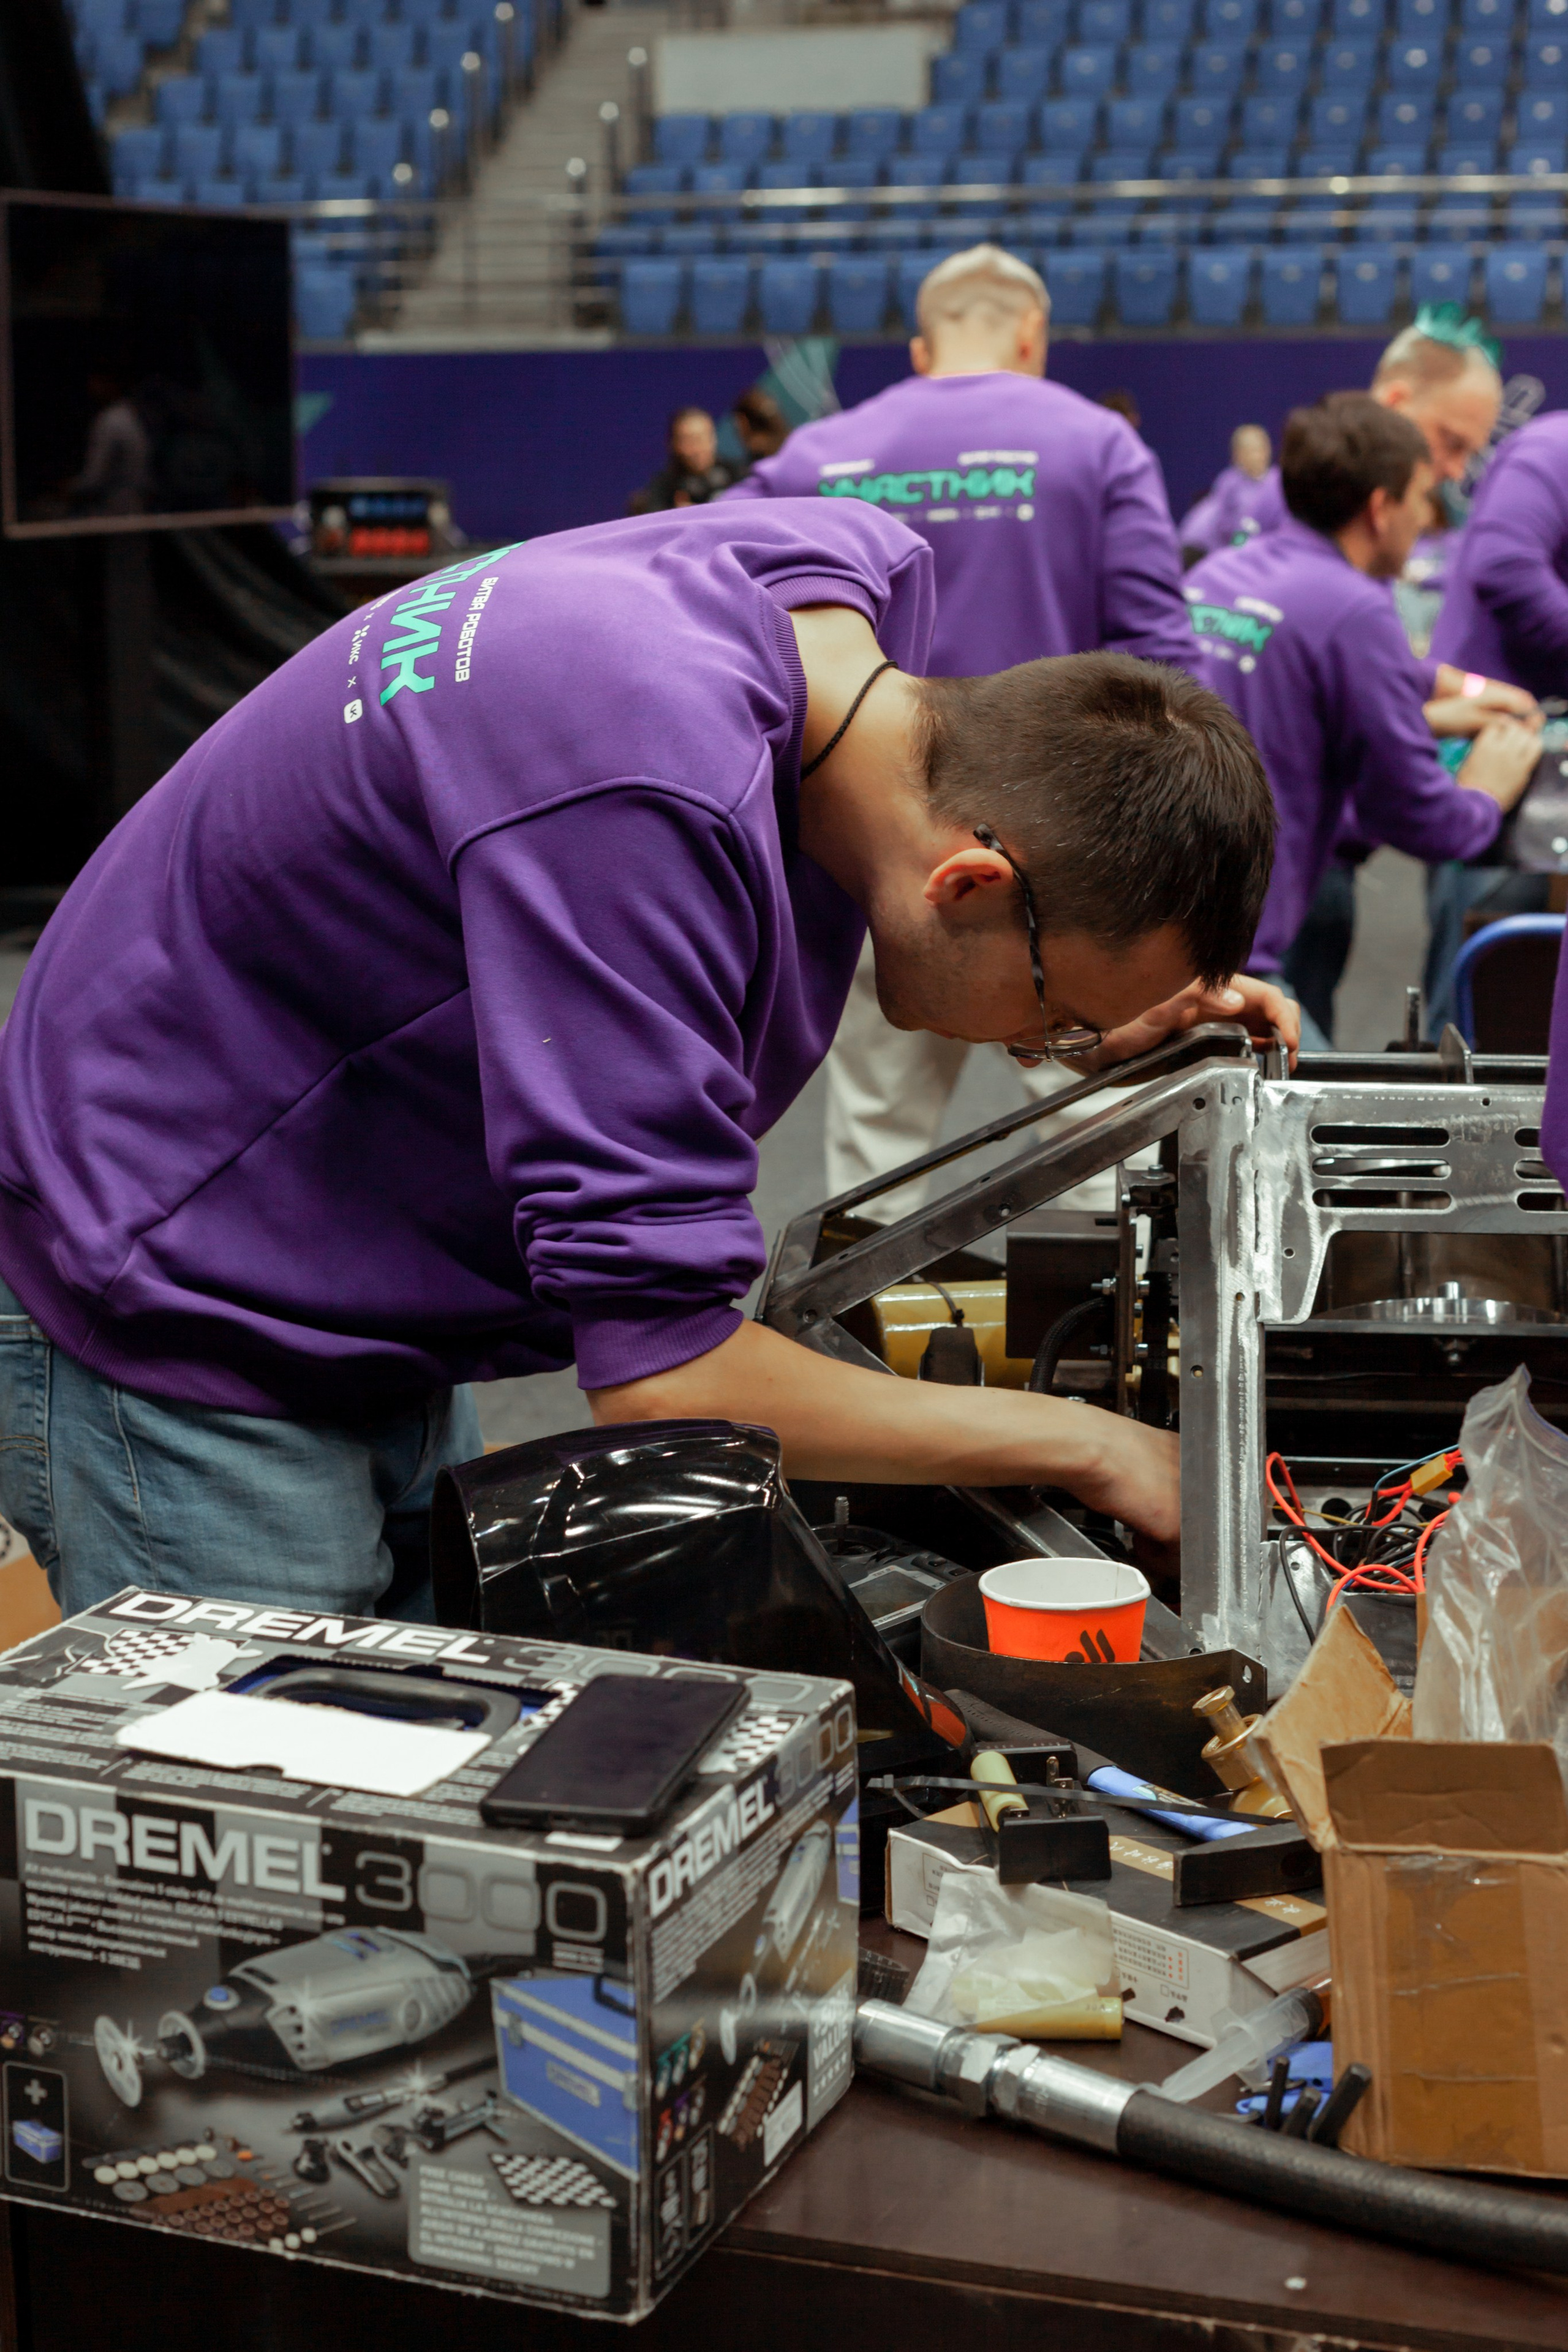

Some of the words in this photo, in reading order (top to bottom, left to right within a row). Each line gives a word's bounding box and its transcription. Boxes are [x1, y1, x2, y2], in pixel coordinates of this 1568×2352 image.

[379, 540, 527, 706] СТНИК
[455, 612, 481, 682] РОБОТОВ
[469, 577, 499, 611] БИТВА
[108, 1592, 491, 1664] DREMEL
[24, 1798, 347, 1902] DREMEL
[355, 1850, 607, 1943] 3000
[649, 1775, 775, 1917] DREMEL
